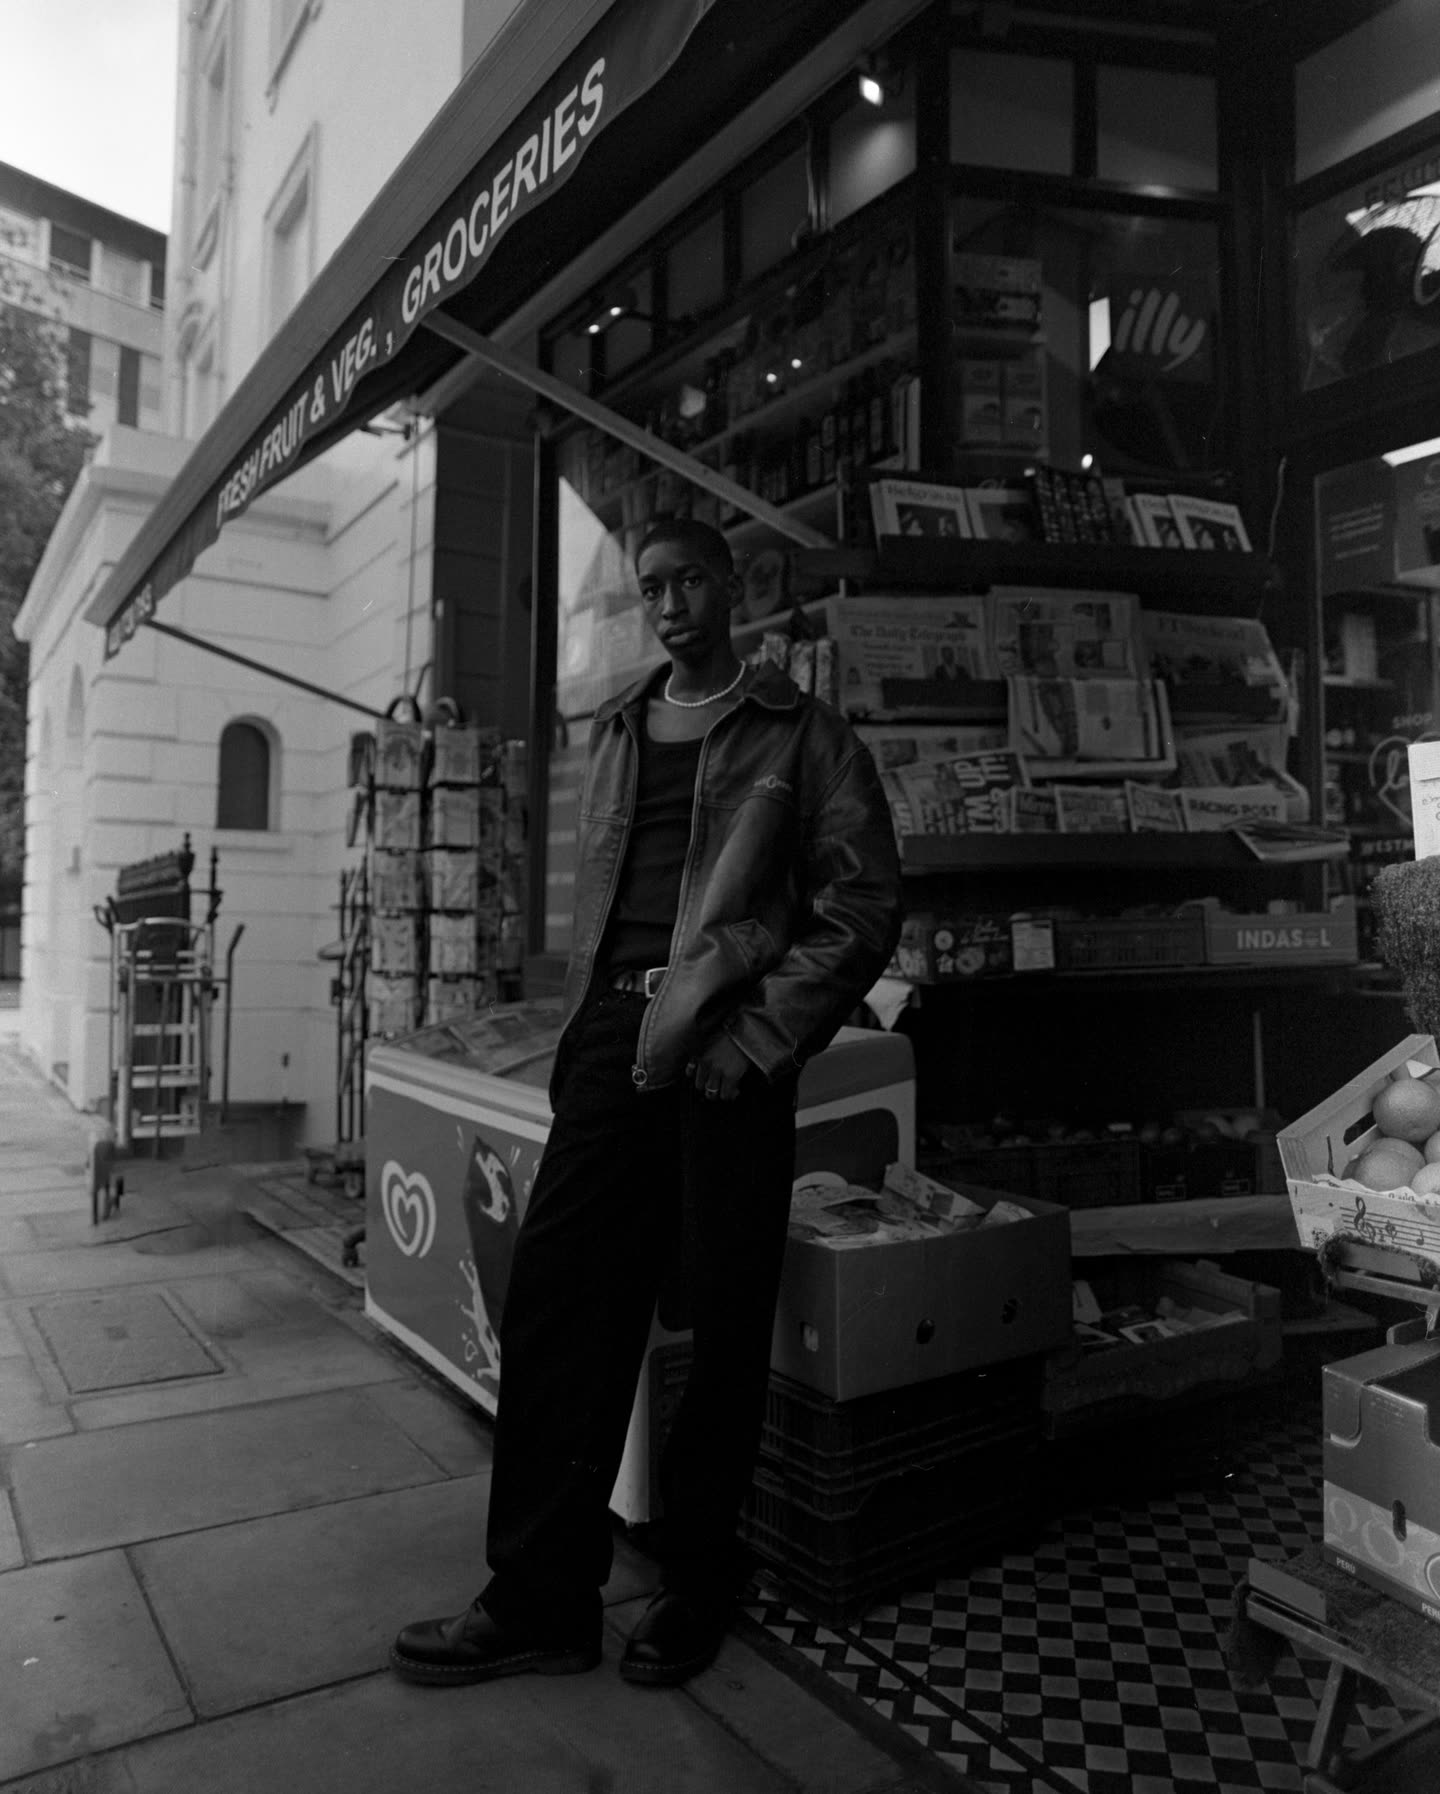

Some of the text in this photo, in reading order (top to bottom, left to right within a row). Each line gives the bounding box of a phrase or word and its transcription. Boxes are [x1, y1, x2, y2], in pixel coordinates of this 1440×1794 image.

[259, 391, 308, 479] FRUIT
[310, 374, 325, 423] &
[331, 317, 377, 403] VEG.
[401, 57, 606, 324] GROCERIES
[1114, 287, 1207, 372] illy
[850, 624, 967, 643] The Daily Telegraph
[1392, 713, 1433, 729] SHOP
[954, 760, 986, 788] UP
[1189, 798, 1279, 818] RACING POST
